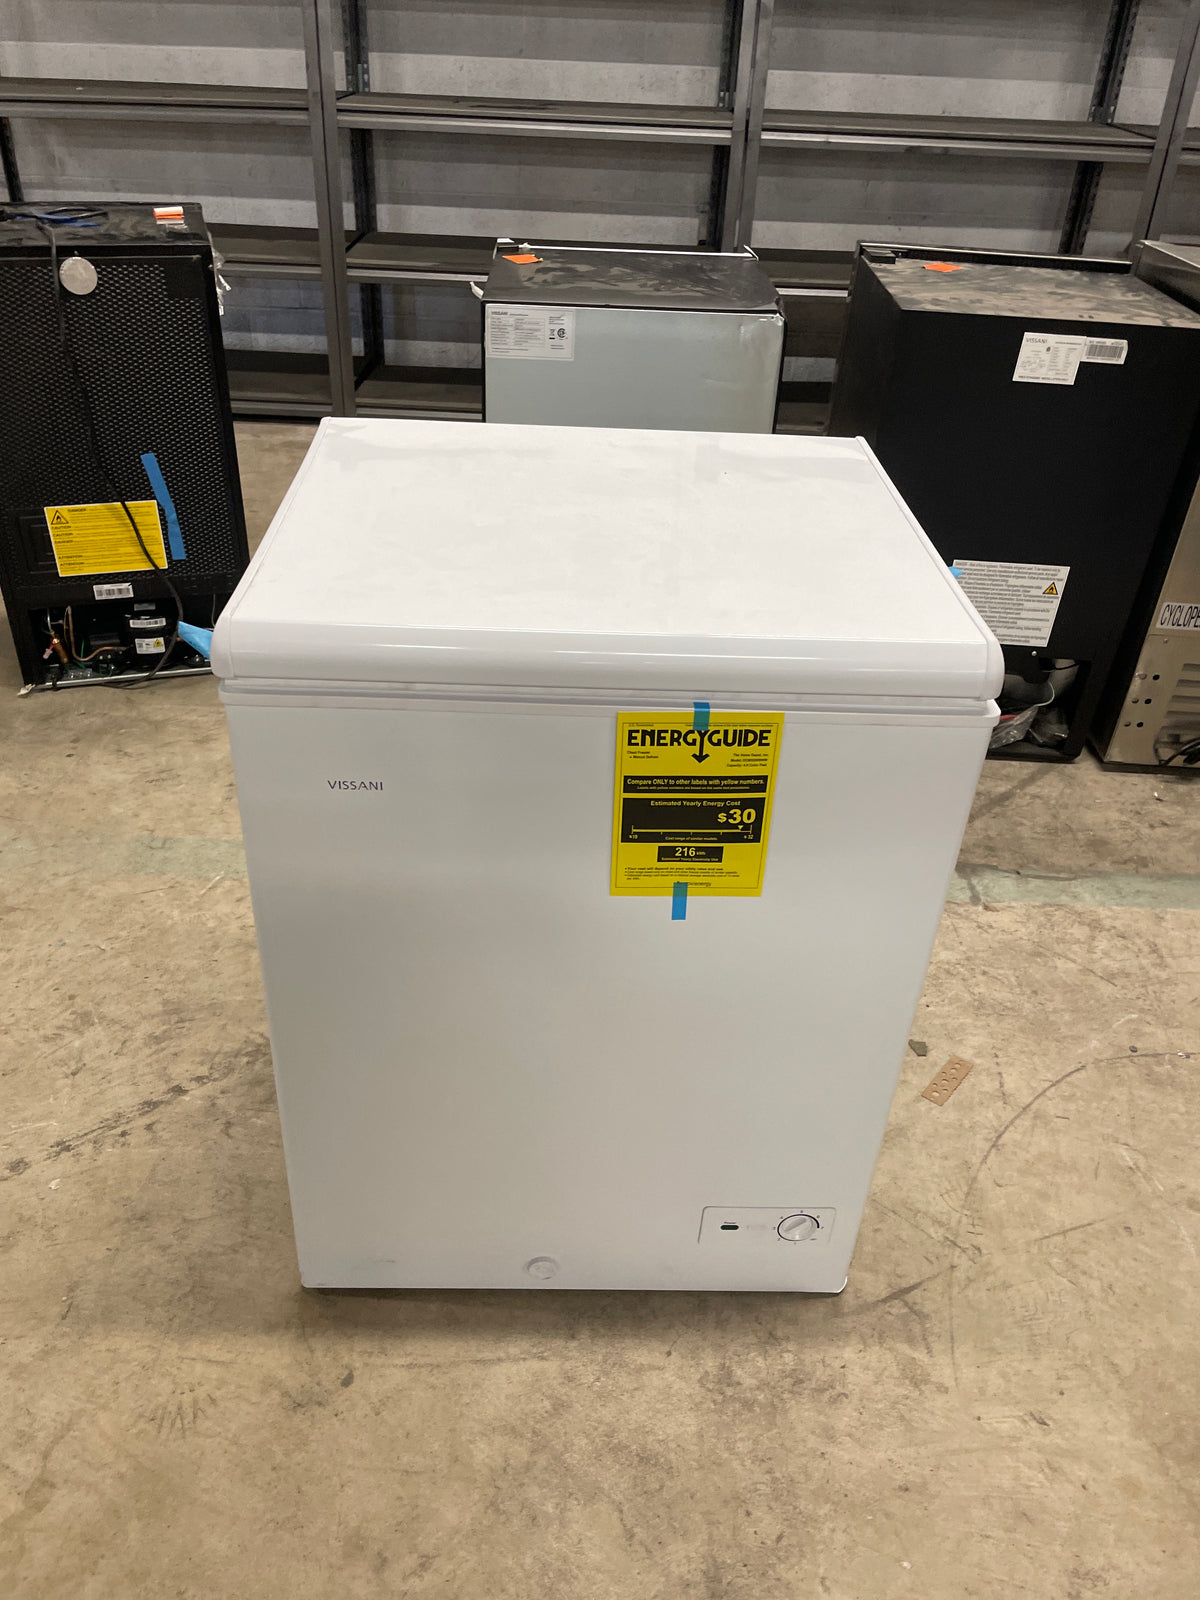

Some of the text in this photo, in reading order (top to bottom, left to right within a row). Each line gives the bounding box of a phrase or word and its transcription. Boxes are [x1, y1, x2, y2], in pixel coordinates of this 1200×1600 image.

[627, 729, 771, 747] ENERGYGUIDE
[327, 780, 383, 790] VISSANI
[717, 808, 756, 824] $30
[674, 847, 696, 857] 216
